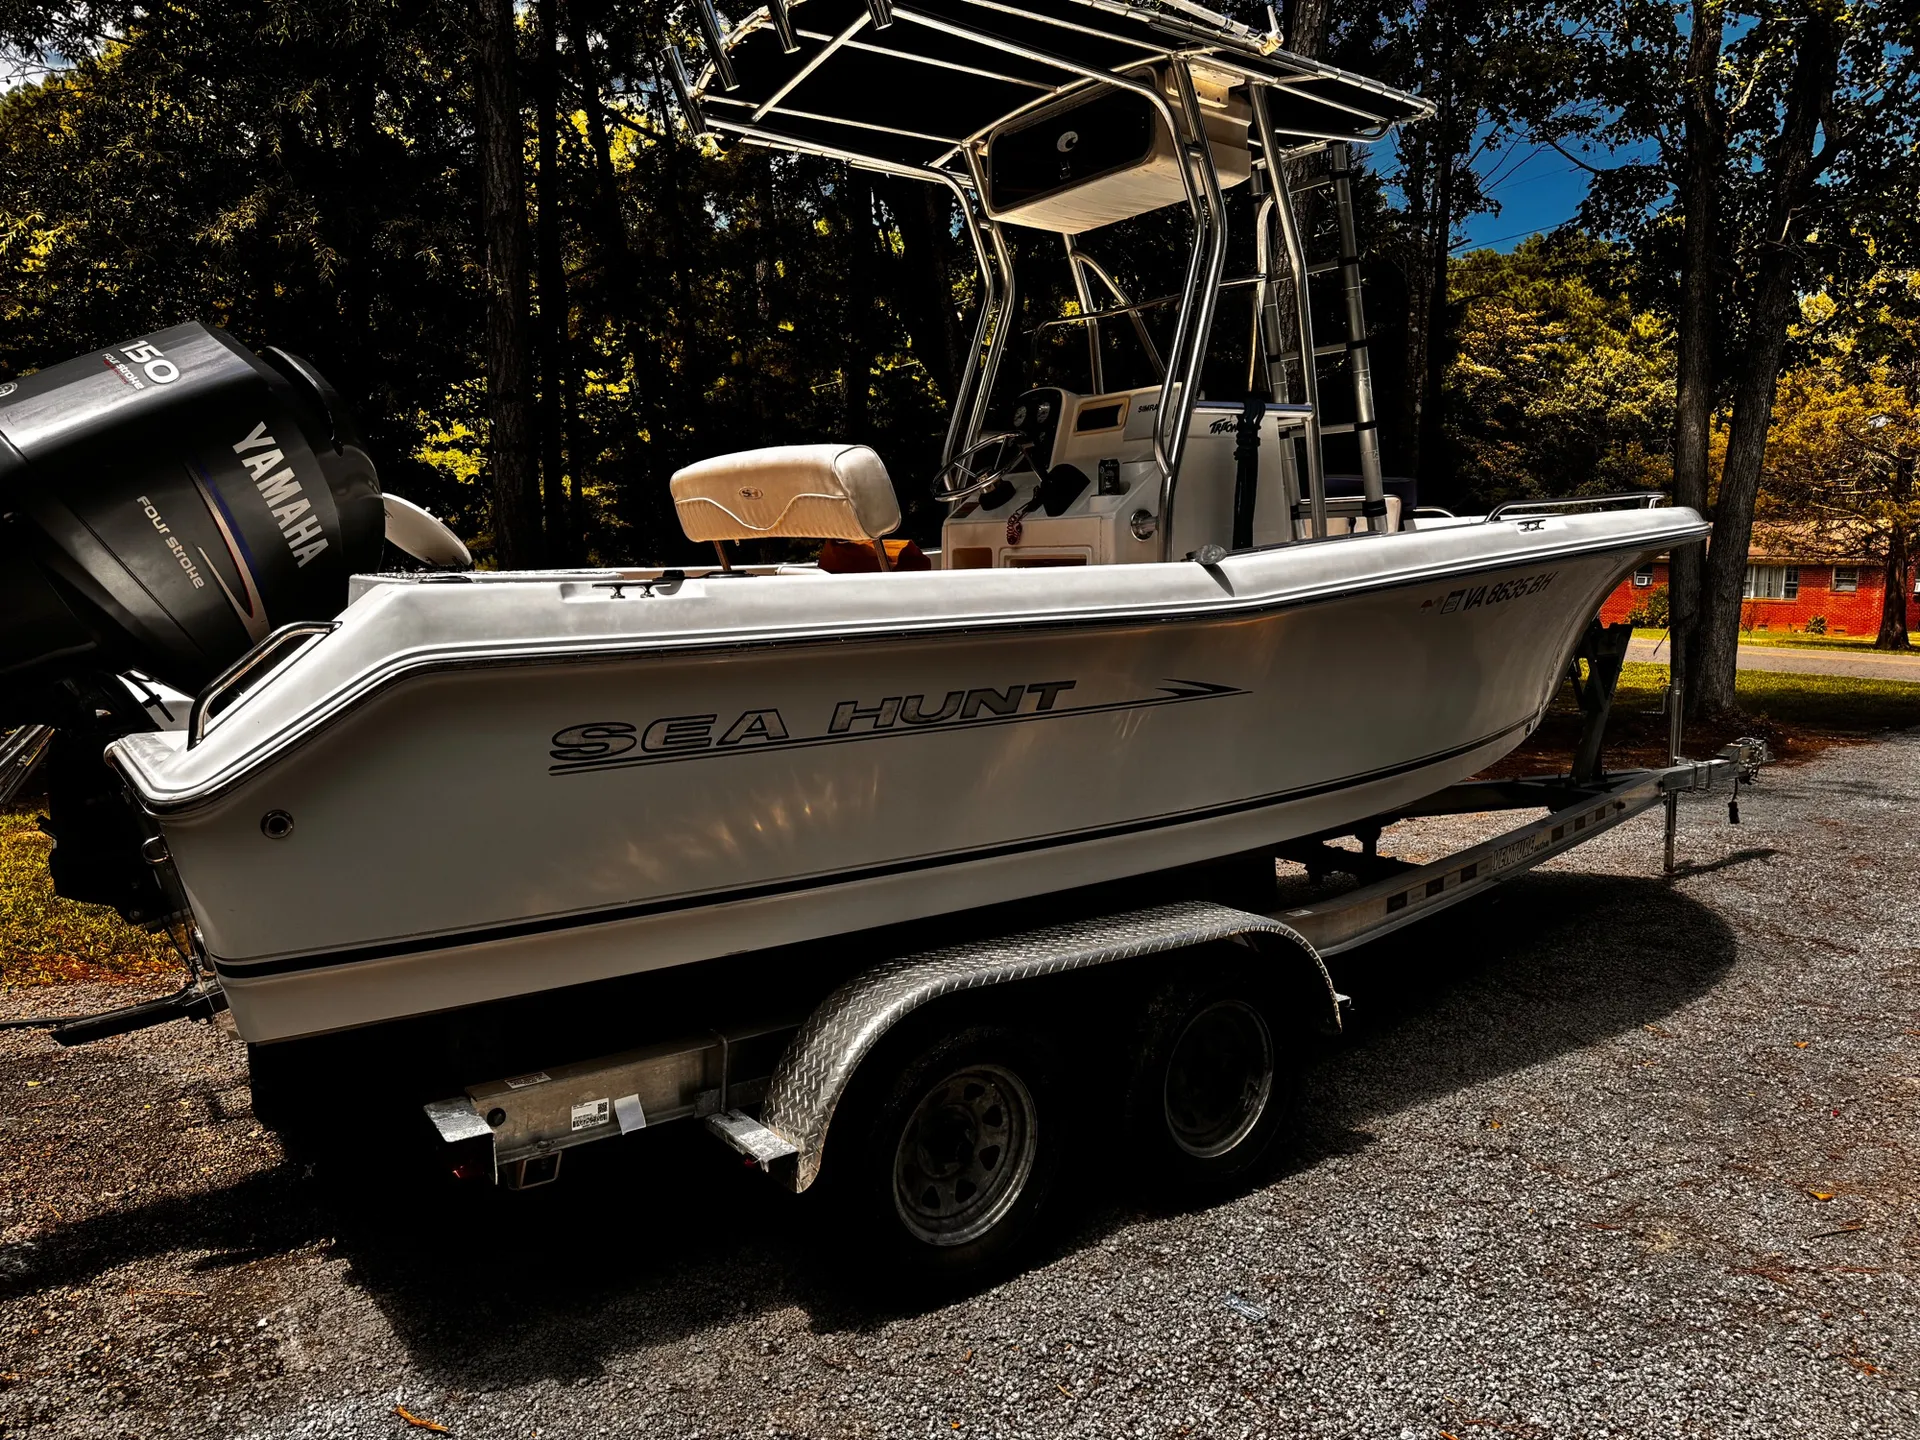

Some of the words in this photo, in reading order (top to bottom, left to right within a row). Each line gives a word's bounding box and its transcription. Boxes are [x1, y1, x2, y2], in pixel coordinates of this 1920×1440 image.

[119, 340, 180, 385] 150
[1138, 403, 1159, 413] SIMRA
[232, 421, 329, 568] YAMAHA
[1462, 585, 1489, 611] VA
[1486, 576, 1535, 606] 8635
[1526, 570, 1560, 596] BH
[548, 708, 790, 762] SEA
[827, 680, 1077, 734] HUNT
